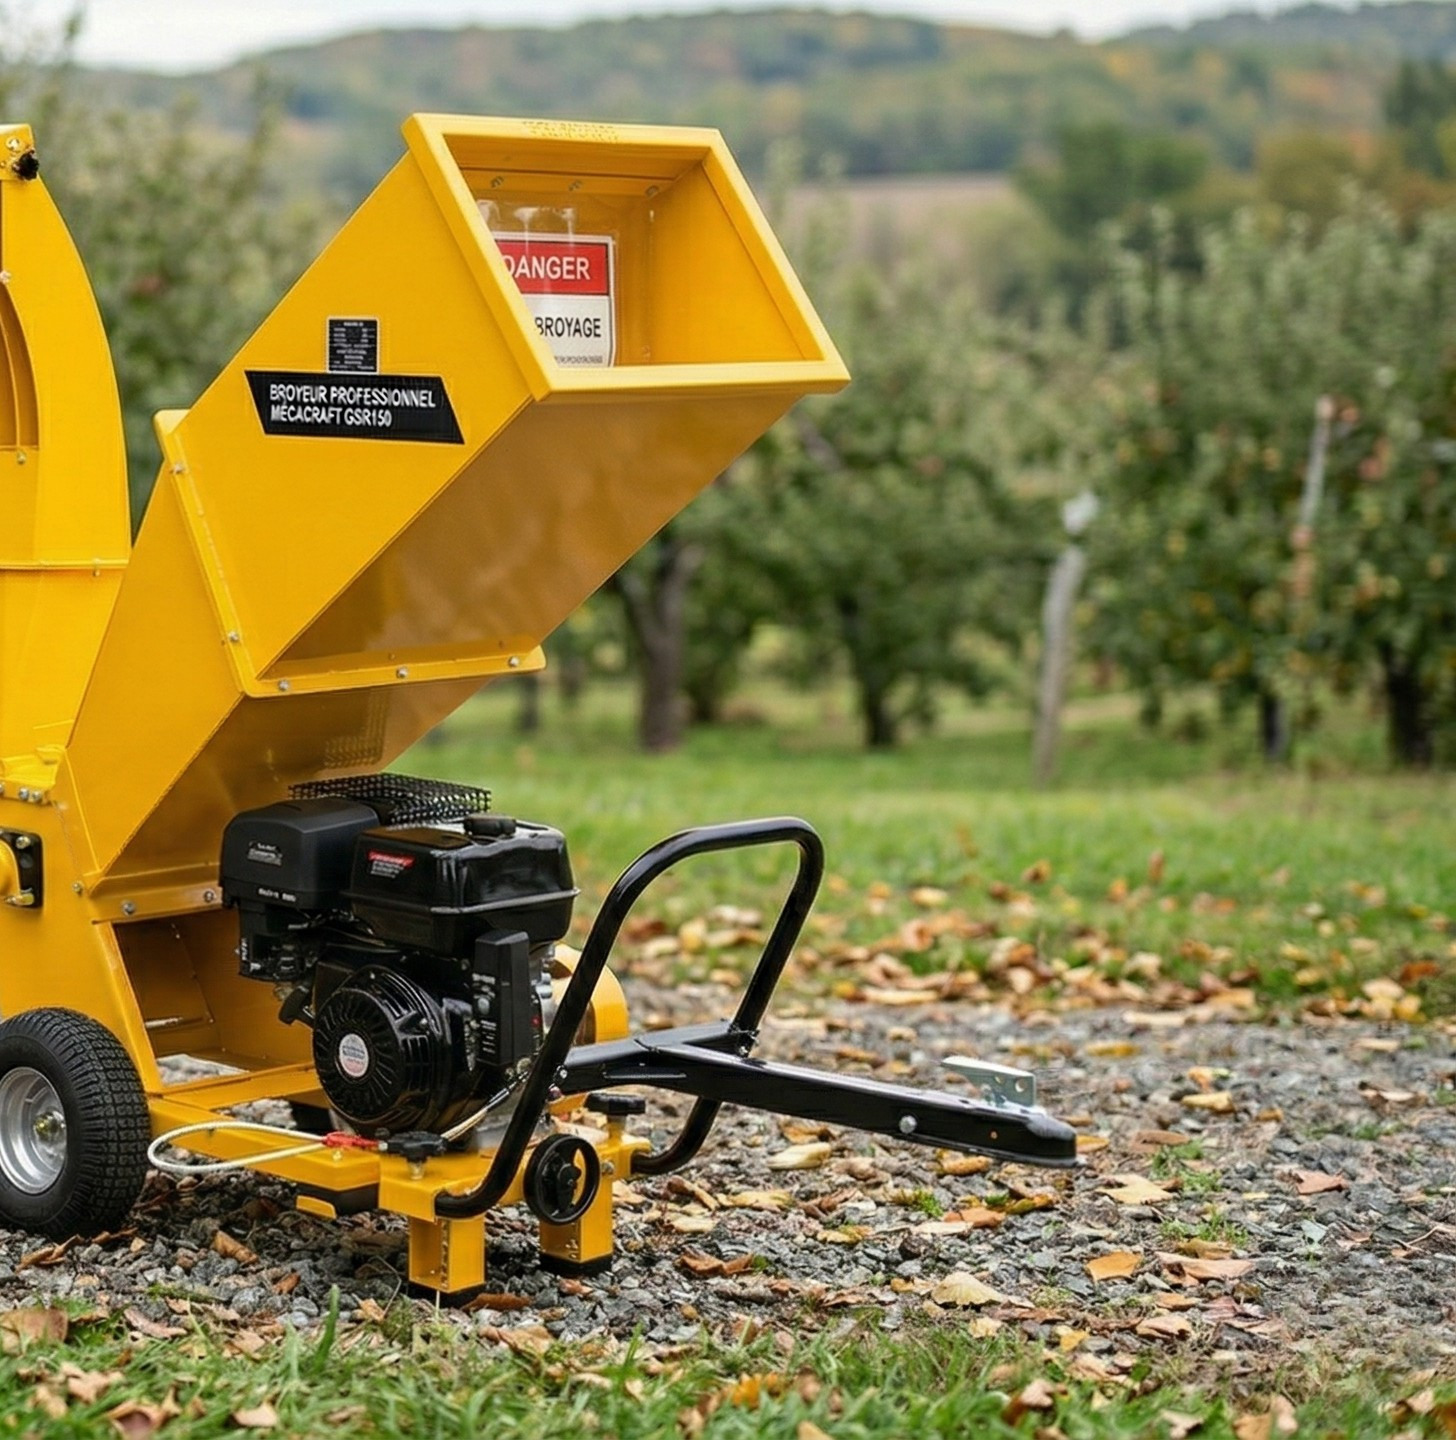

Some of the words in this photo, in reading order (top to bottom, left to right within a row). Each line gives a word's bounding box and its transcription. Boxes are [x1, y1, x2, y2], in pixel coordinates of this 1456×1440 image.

[535, 316, 602, 338] BROYAGE
[269, 384, 328, 403] BROYEUR
[330, 386, 436, 407] PROFESSIONNEL
[344, 408, 392, 427] GSR150
